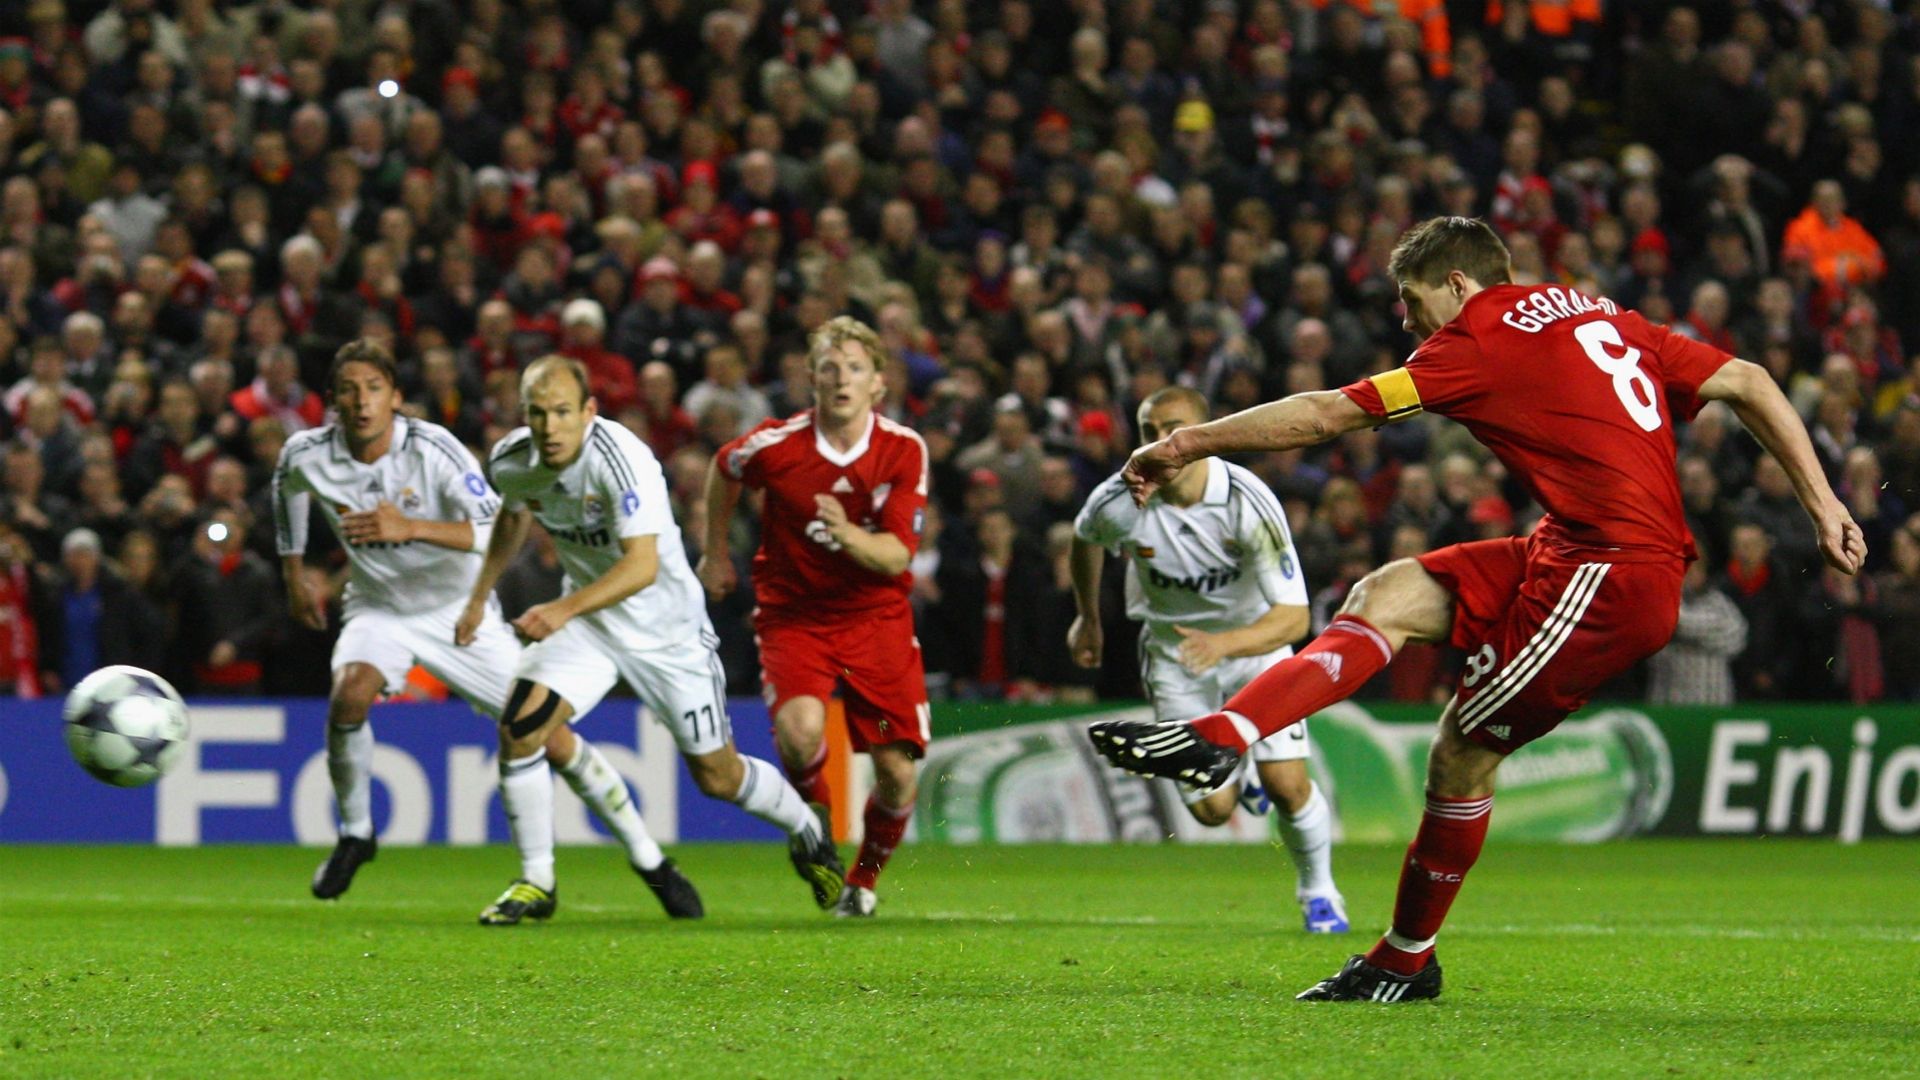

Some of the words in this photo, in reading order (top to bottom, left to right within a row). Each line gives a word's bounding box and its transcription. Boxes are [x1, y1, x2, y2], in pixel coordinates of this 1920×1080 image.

[1574, 320, 1663, 432] 8
[1463, 643, 1497, 688] 8
[154, 703, 679, 846] Ford
[1700, 717, 1920, 845] Enjo
